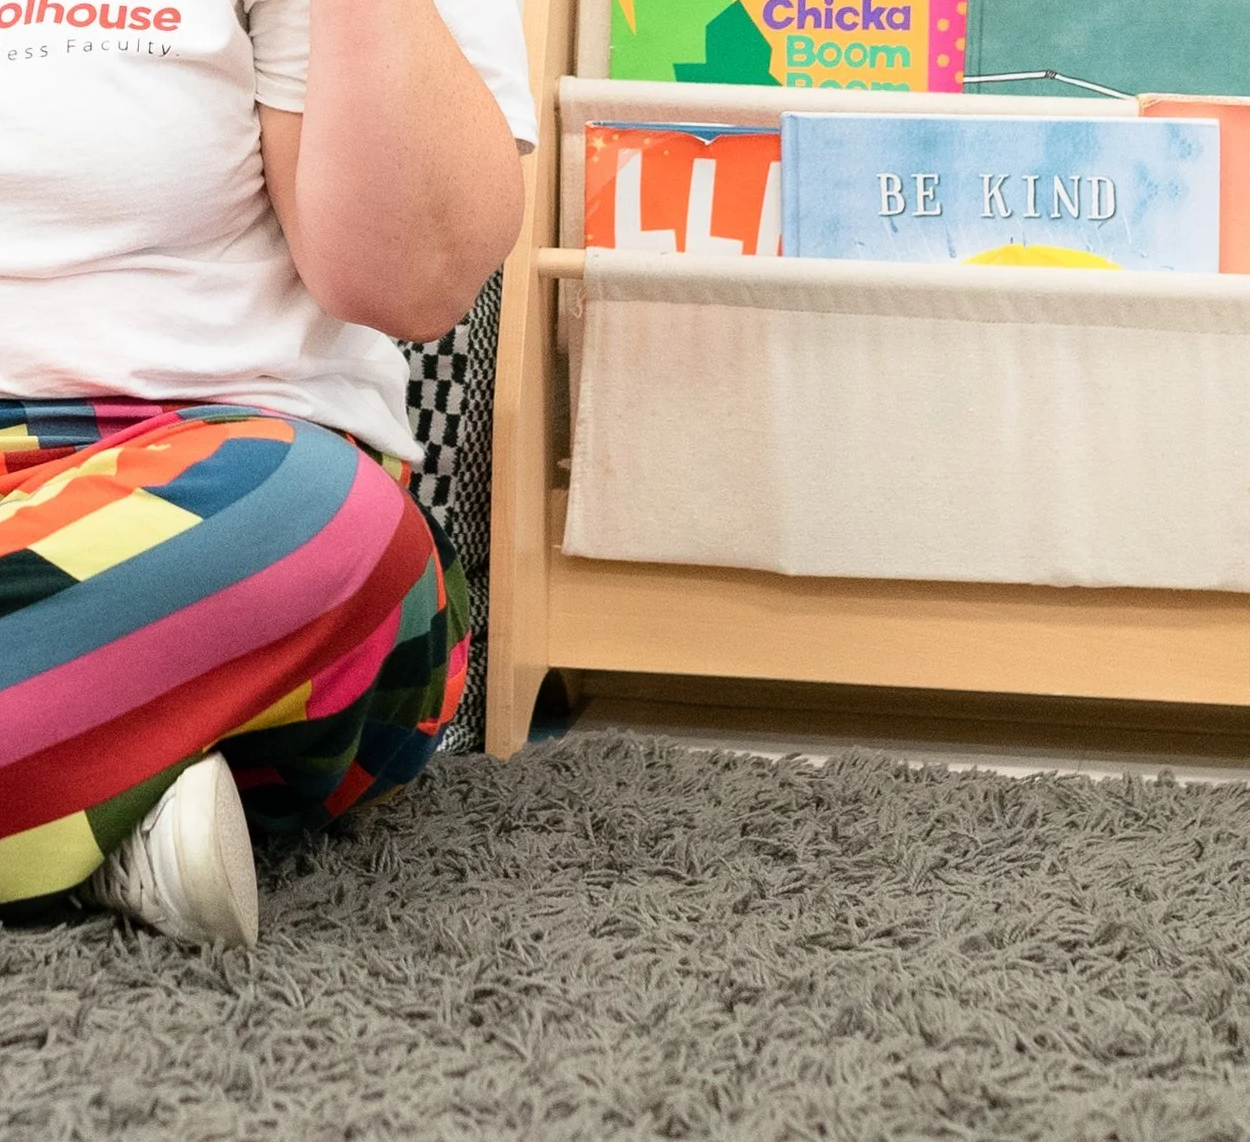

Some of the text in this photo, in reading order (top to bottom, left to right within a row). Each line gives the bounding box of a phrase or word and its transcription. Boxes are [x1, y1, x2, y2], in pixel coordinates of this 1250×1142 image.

[66, 37, 181, 58] Faculty.
[786, 35, 911, 68] Boom
[614, 148, 780, 255] LL
[876, 172, 1118, 221] BE KIND
